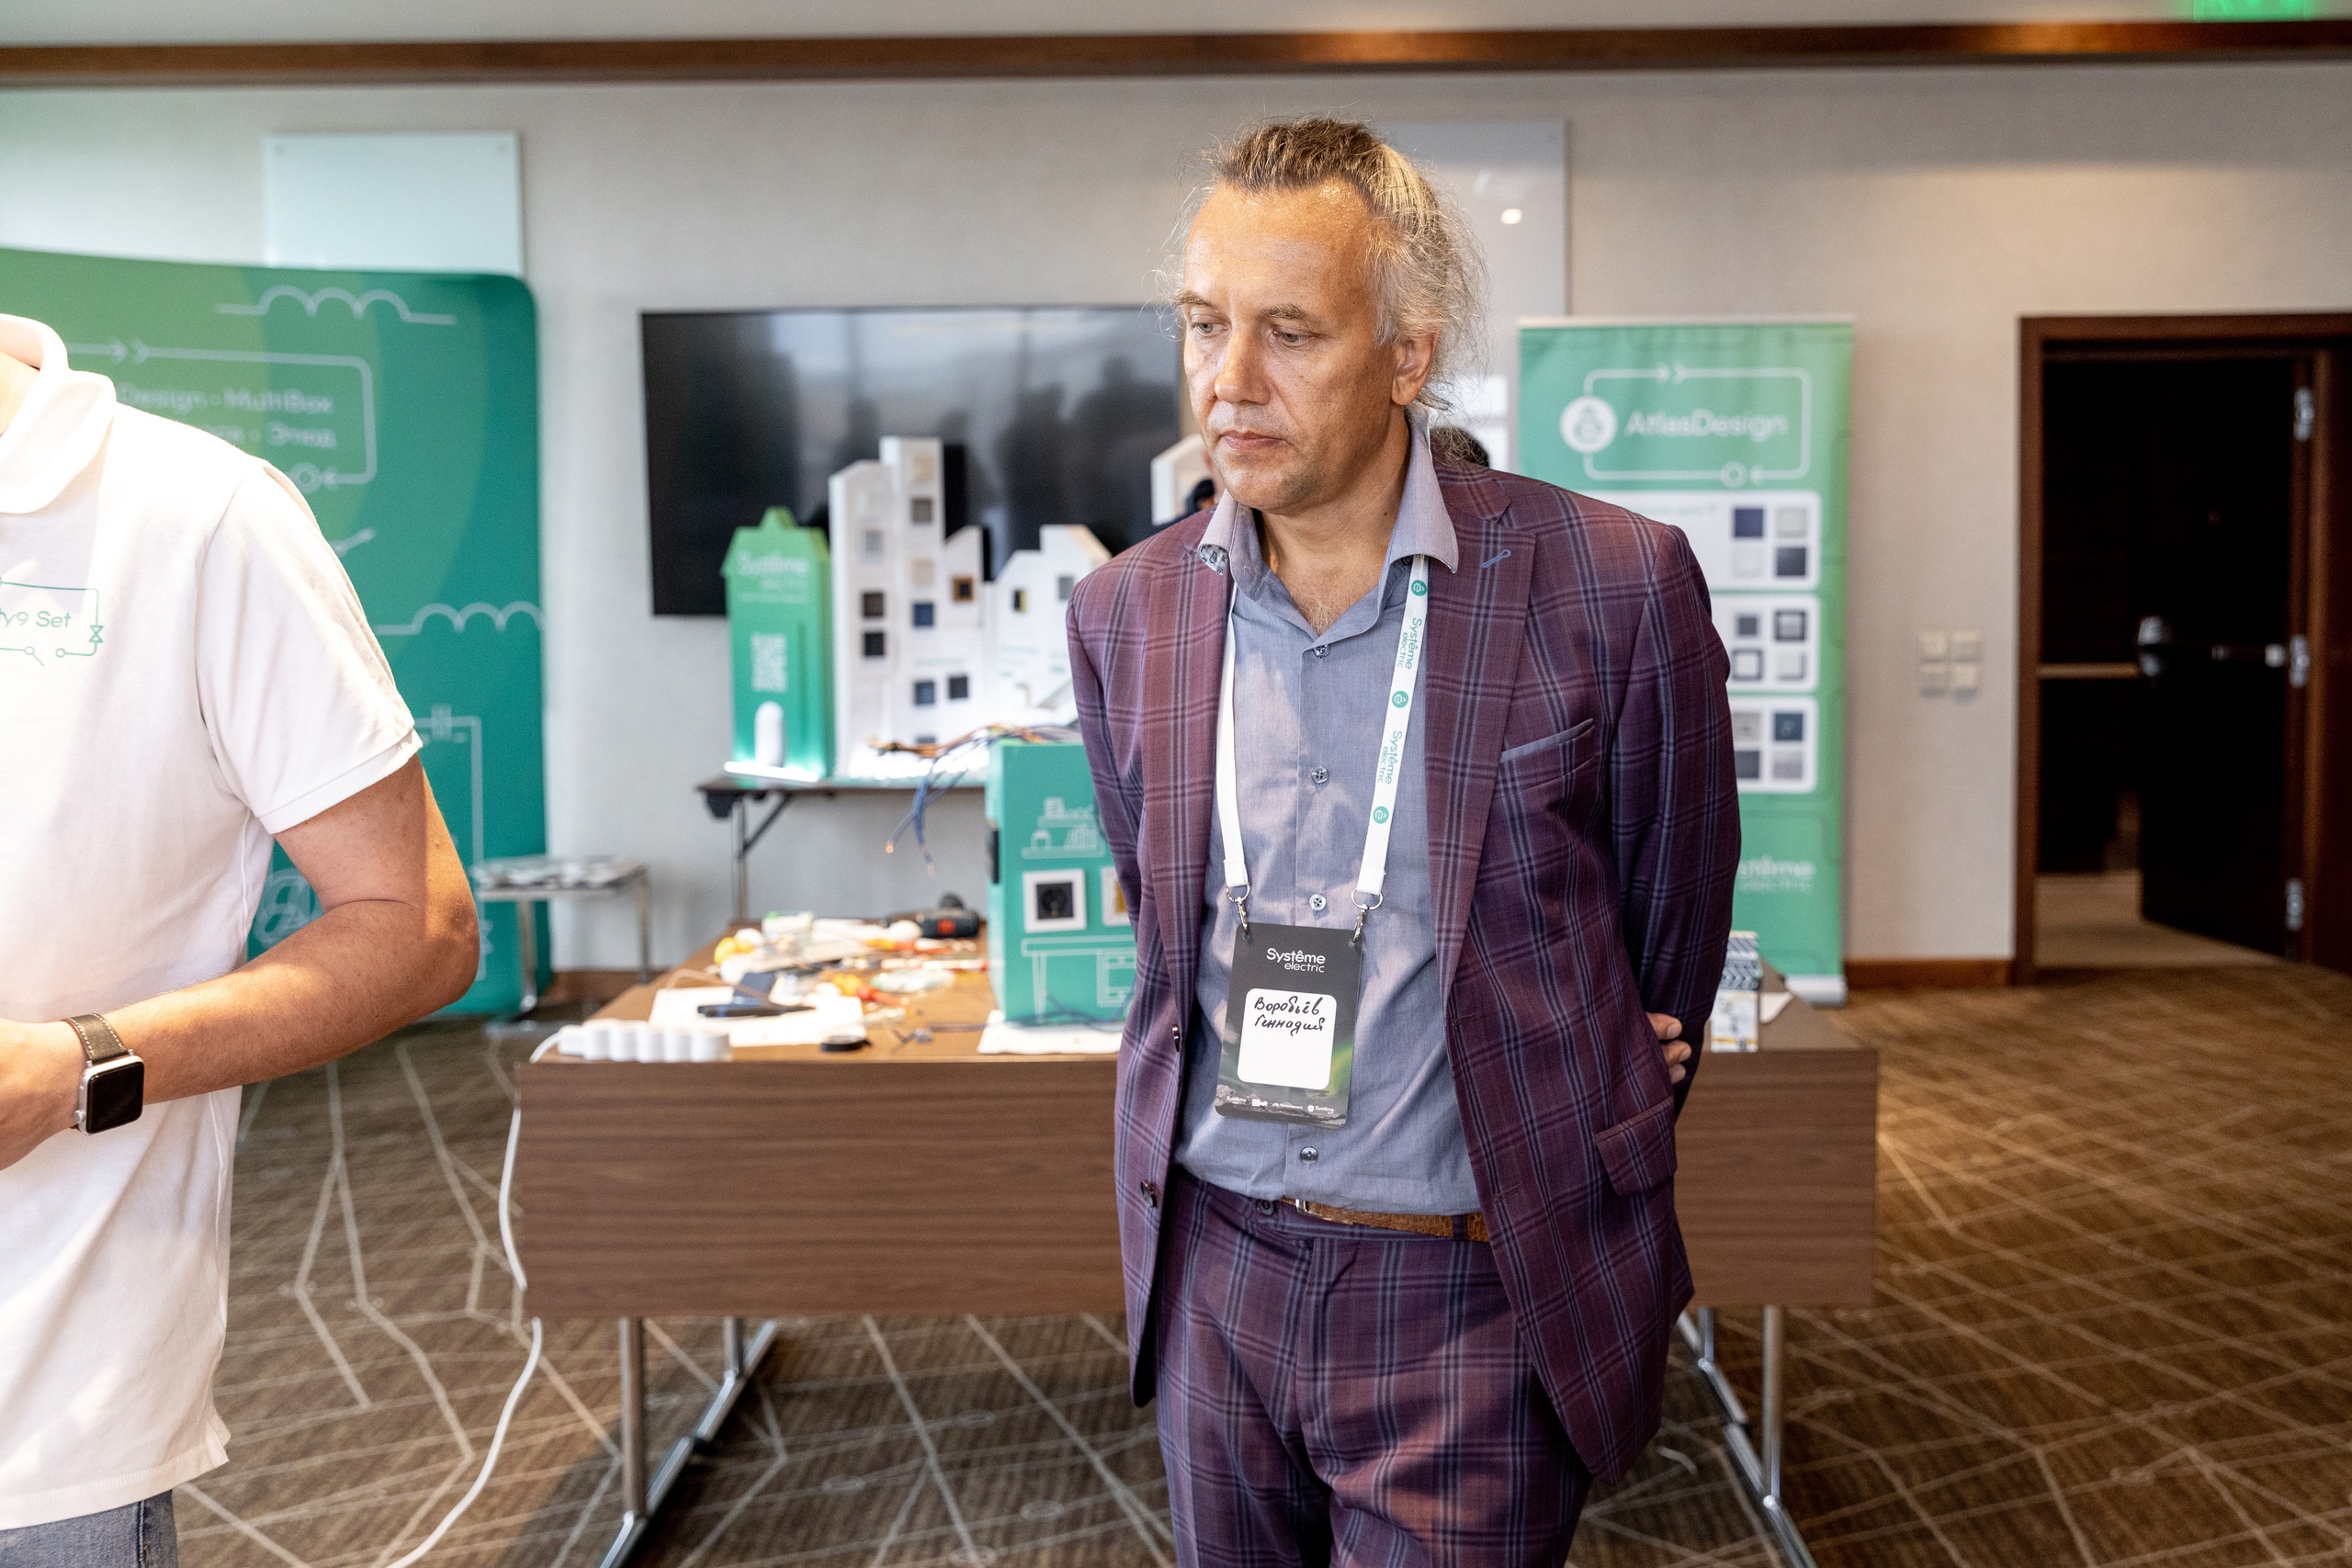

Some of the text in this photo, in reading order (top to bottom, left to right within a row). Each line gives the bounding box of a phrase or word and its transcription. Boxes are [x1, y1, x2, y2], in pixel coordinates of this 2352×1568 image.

[116, 382, 208, 414] Design
[1624, 409, 1789, 442] AtlasDesign
[0, 606, 72, 628] y9 Set
[1397, 632, 1408, 669] electric
[1405, 617, 1422, 670] Systême
[1378, 746, 1388, 784] electric
[1385, 730, 1403, 785] Systême
[1266, 947, 1326, 964] Systême
[1283, 961, 1325, 973] electric
[1254, 1014, 1326, 1036] Геннадий
